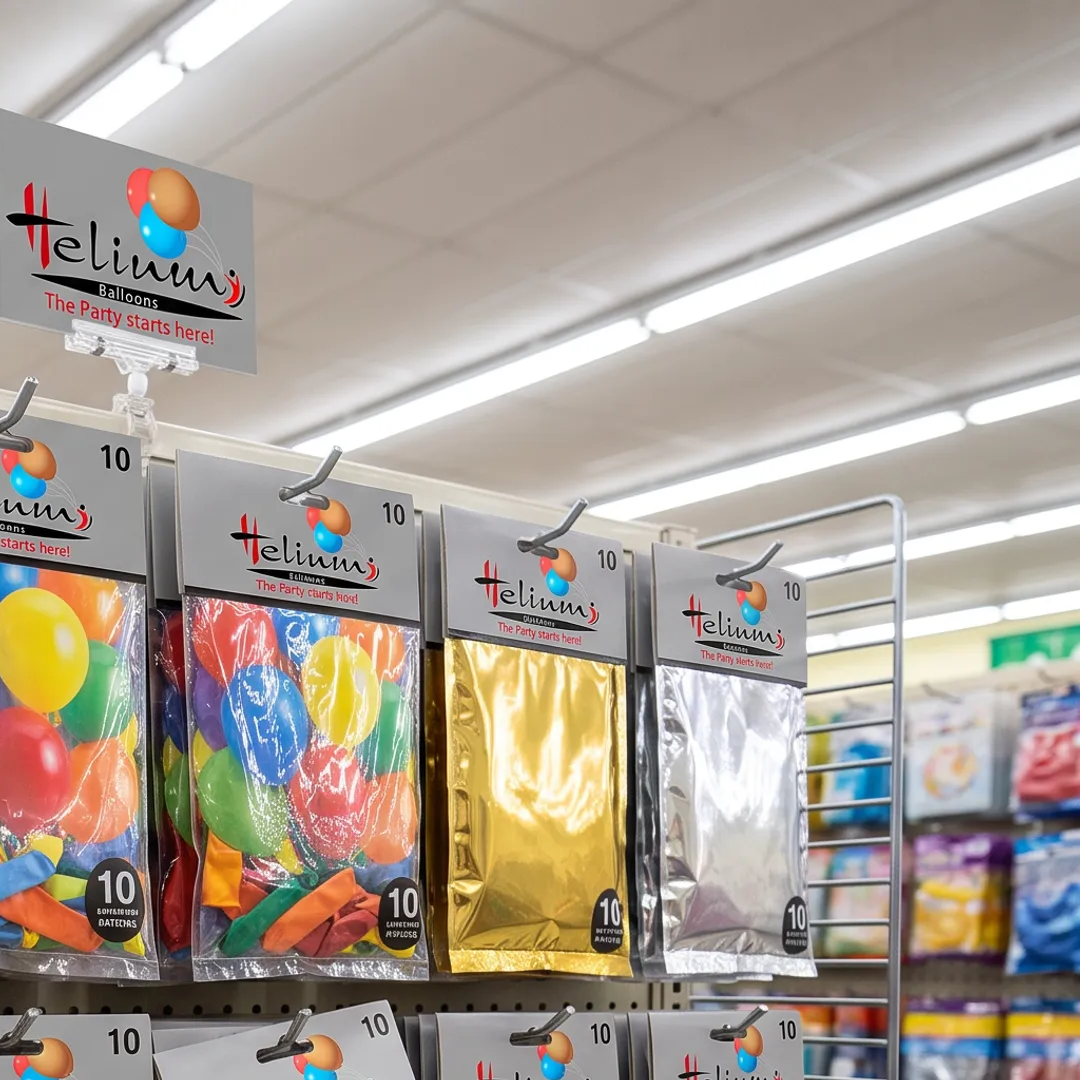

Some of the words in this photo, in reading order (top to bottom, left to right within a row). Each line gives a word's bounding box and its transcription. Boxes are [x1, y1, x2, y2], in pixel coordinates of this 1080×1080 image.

[5, 182, 227, 295] Helium
[99, 284, 158, 309] Balloons
[45, 292, 75, 314] The
[80, 300, 122, 328] Party
[127, 312, 170, 335] starts
[175, 321, 215, 345] here!
[100, 444, 131, 472] 10
[382, 502, 405, 526] 10
[0, 537, 36, 552] starts
[39, 541, 71, 558] here!
[230, 513, 366, 574] Helium
[597, 549, 617, 571] 10
[256, 579, 276, 592] The
[279, 584, 305, 598] Party
[474, 559, 588, 618] Helium
[783, 581, 801, 601] 10
[498, 621, 513, 634] The
[516, 625, 536, 640] Party
[538, 630, 560, 643] starts
[681, 593, 777, 645] Helium
[98, 870, 135, 905] 10
[388, 887, 419, 919] 10
[600, 897, 621, 926] 10
[788, 904, 806, 930] 10
[361, 1012, 390, 1039] 10
[590, 1023, 611, 1044] 10
[779, 1020, 797, 1040] 10
[108, 1028, 140, 1055] 10
